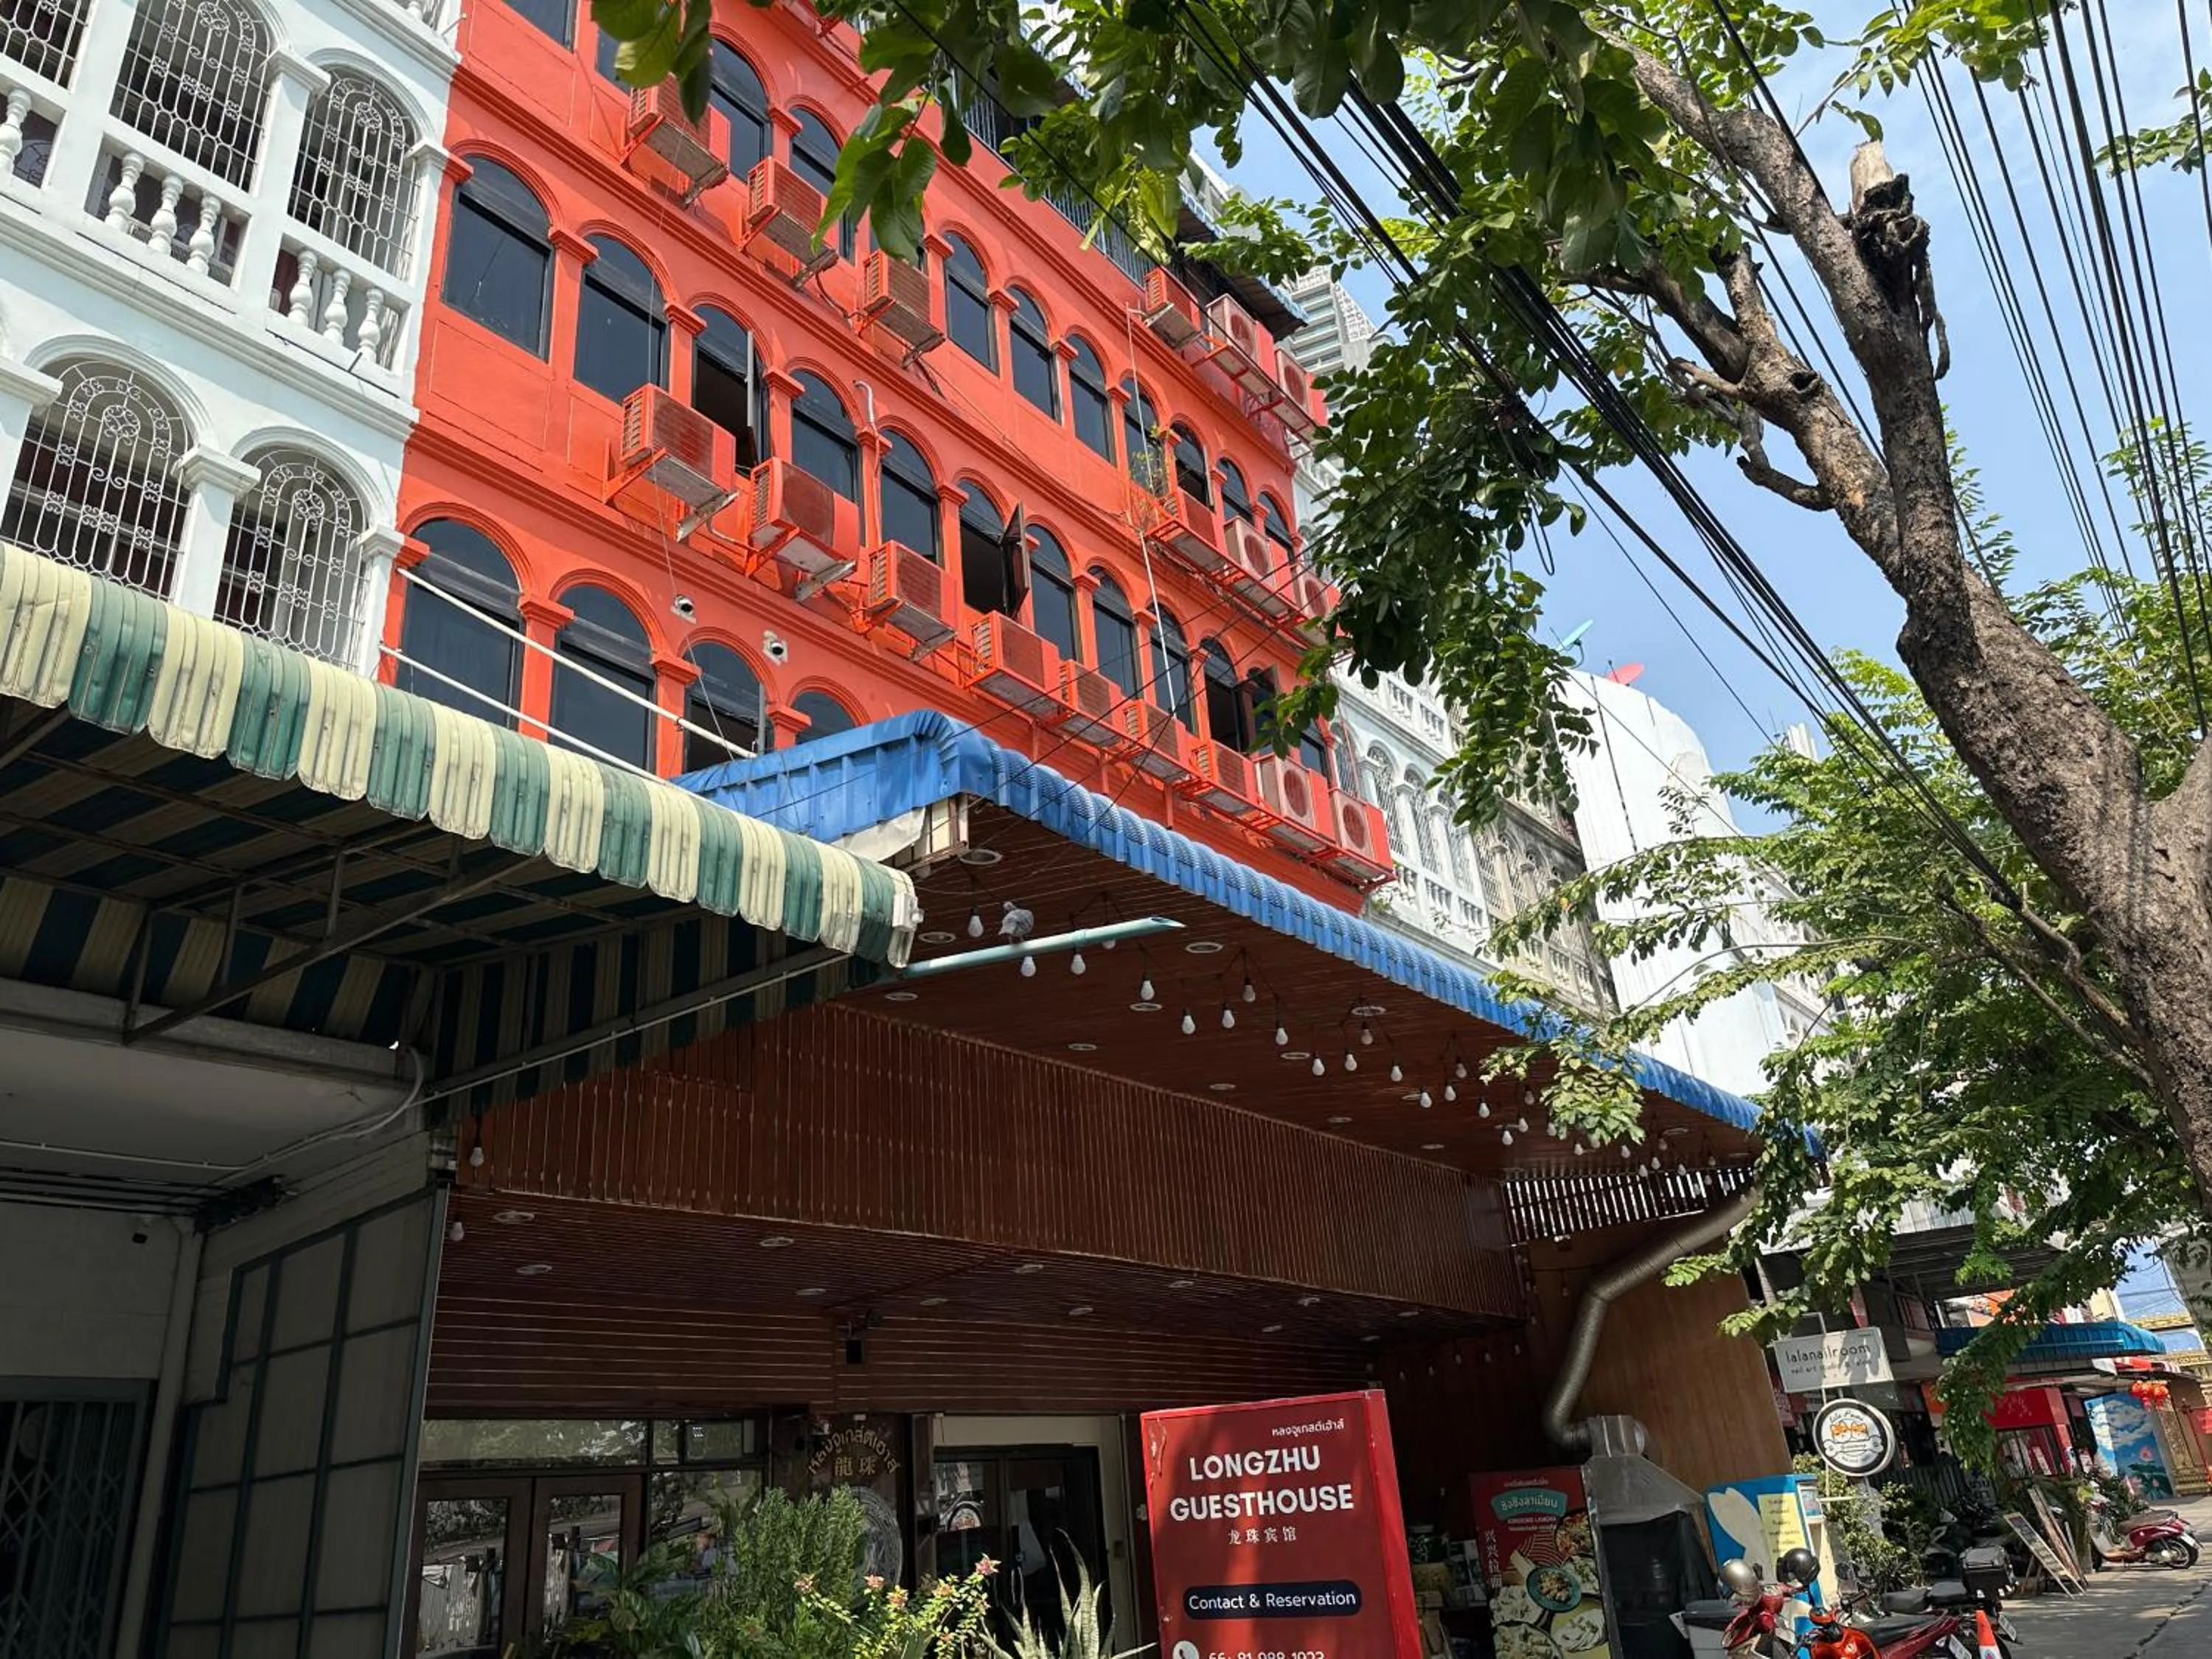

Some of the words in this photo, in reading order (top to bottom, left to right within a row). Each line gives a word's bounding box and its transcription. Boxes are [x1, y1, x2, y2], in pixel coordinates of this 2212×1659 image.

[835, 1455, 875, 1476] 龍珠
[1189, 1445, 1321, 1481] LONGZHU
[1170, 1484, 1354, 1522] GUESTHOUSE
[1228, 1526, 1297, 1545] 龙珠宾馆
[1189, 1594, 1244, 1610] Contact
[1249, 1593, 1260, 1607] &
[1266, 1591, 1356, 1608] Reservation
